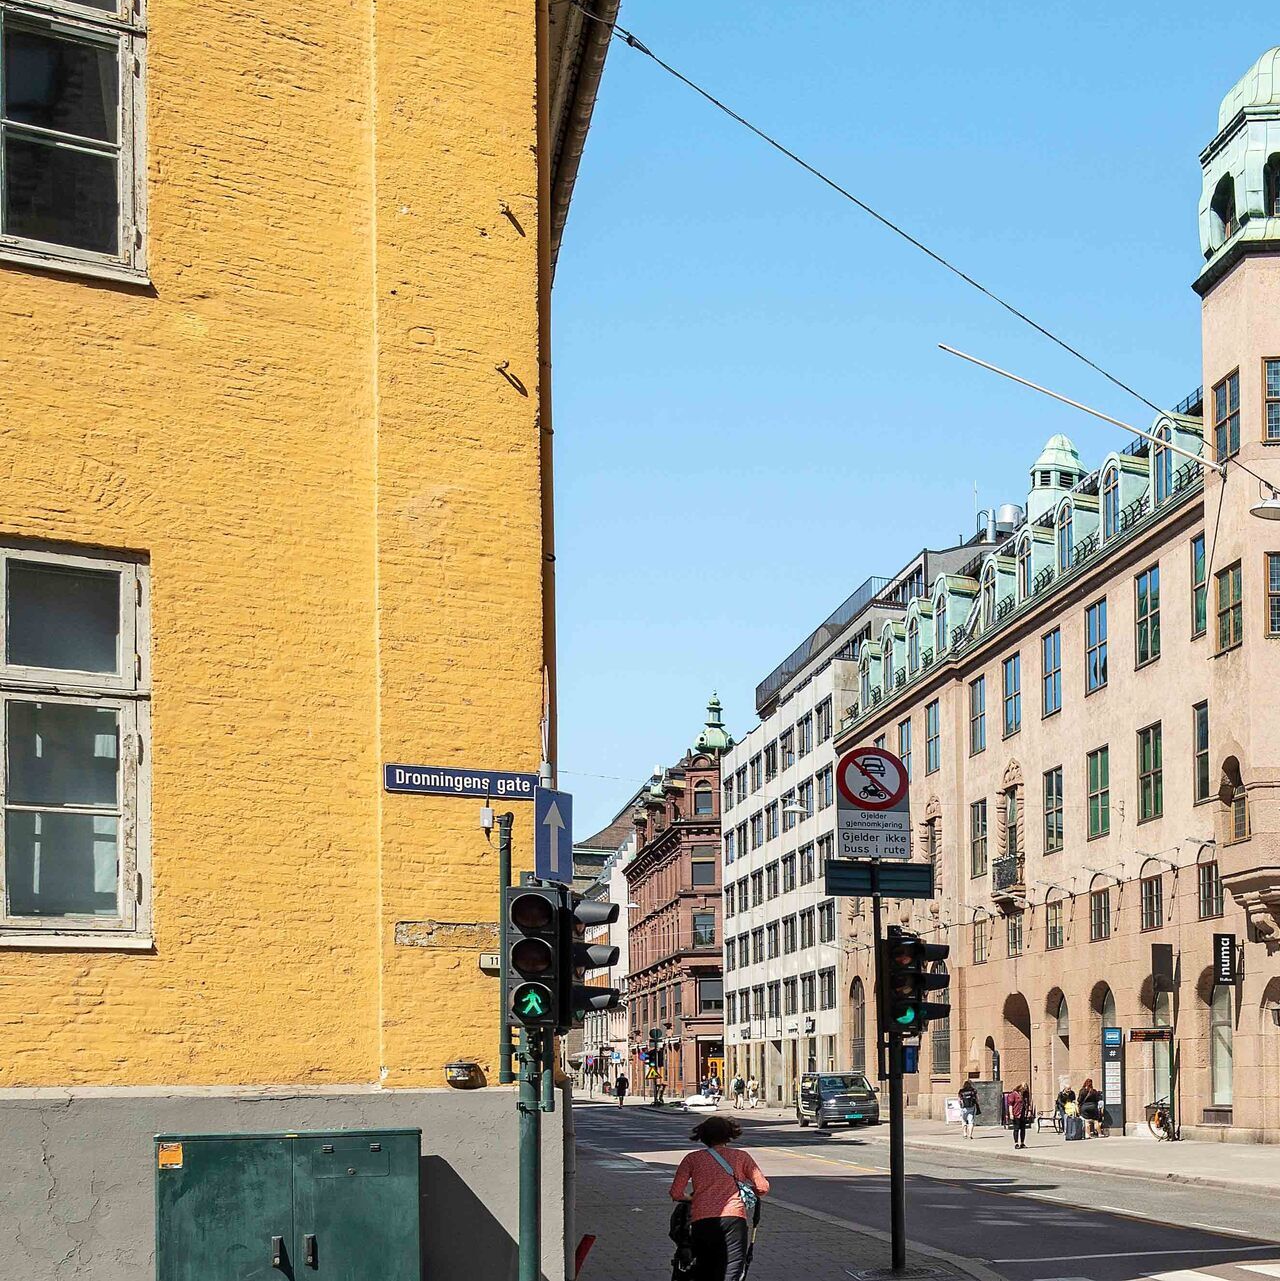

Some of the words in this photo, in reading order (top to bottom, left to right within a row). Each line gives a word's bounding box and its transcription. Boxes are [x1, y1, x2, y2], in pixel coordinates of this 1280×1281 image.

[395, 768, 490, 791] Dronningens
[497, 778, 531, 794] gate
[861, 812, 887, 820] Gjelder
[843, 832, 879, 843] Gjelder
[886, 834, 907, 843] ikke
[844, 844, 870, 853] buss
[884, 846, 906, 854] rute
[1221, 937, 1231, 976] numa
